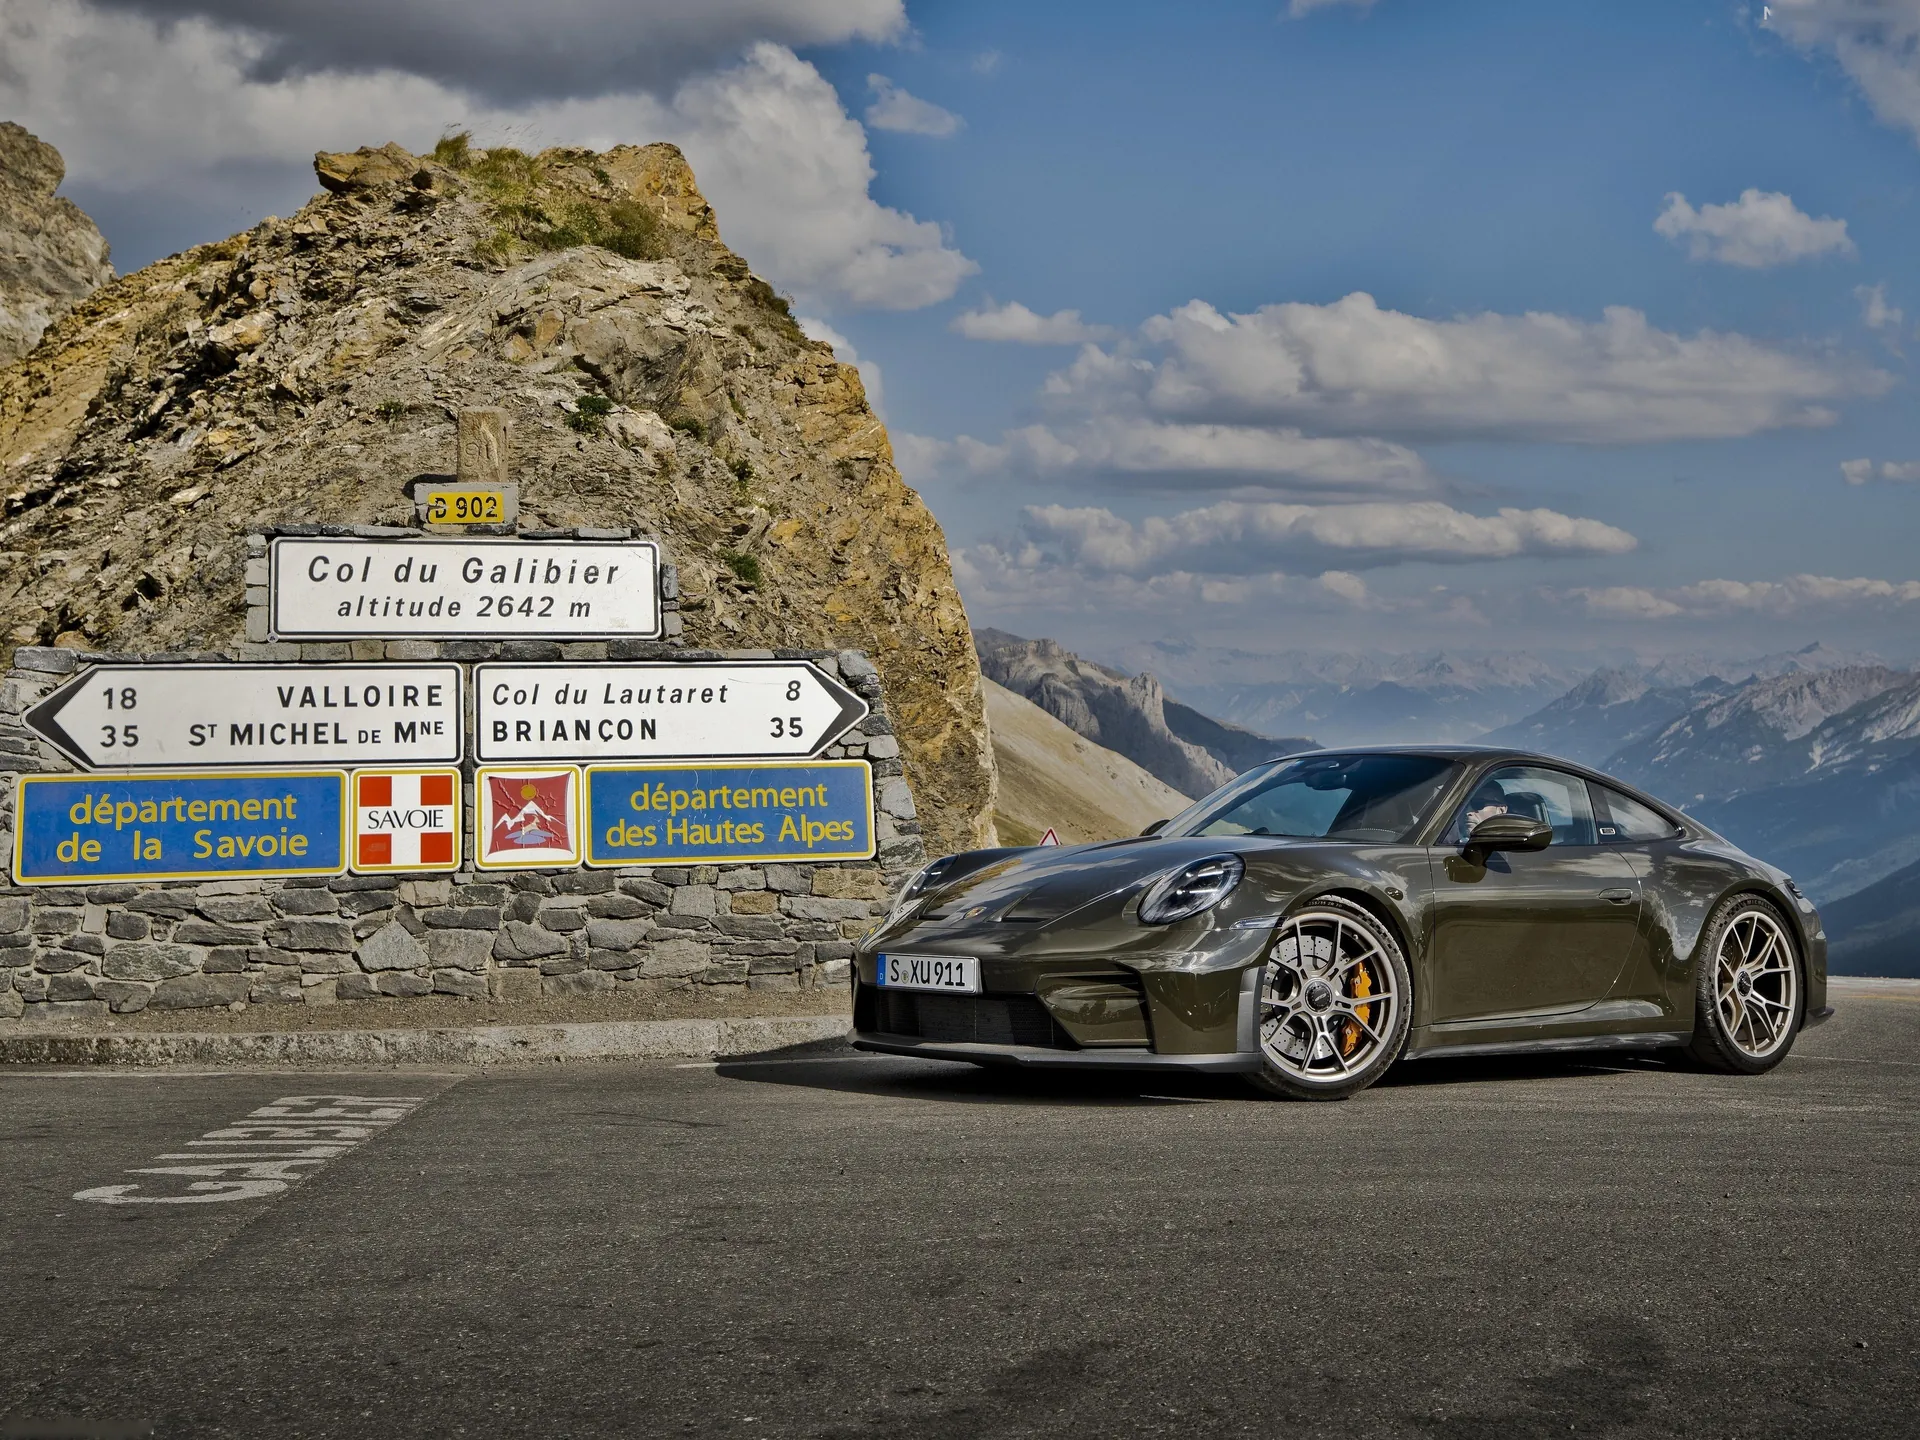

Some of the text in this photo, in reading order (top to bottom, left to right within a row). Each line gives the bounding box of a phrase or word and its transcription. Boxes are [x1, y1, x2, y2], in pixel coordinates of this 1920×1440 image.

[435, 496, 498, 519] D 902
[308, 555, 620, 584] Col du Galibier
[337, 595, 591, 617] altitude 2642 m
[103, 685, 442, 710] 18 VALLOIRE
[492, 680, 801, 706] Col du Lautaret 8
[100, 725, 139, 748] 35
[230, 722, 348, 746] MICHEL
[493, 717, 803, 743] BRIANÇON 35
[630, 783, 829, 814] département
[70, 794, 297, 831] département
[368, 810, 444, 829] SAVOIE
[606, 814, 855, 849] des Hautes Alpes
[57, 829, 309, 863] de la Savoie
[891, 958, 900, 982] S
[72, 1095, 424, 1204] GALIBIER
